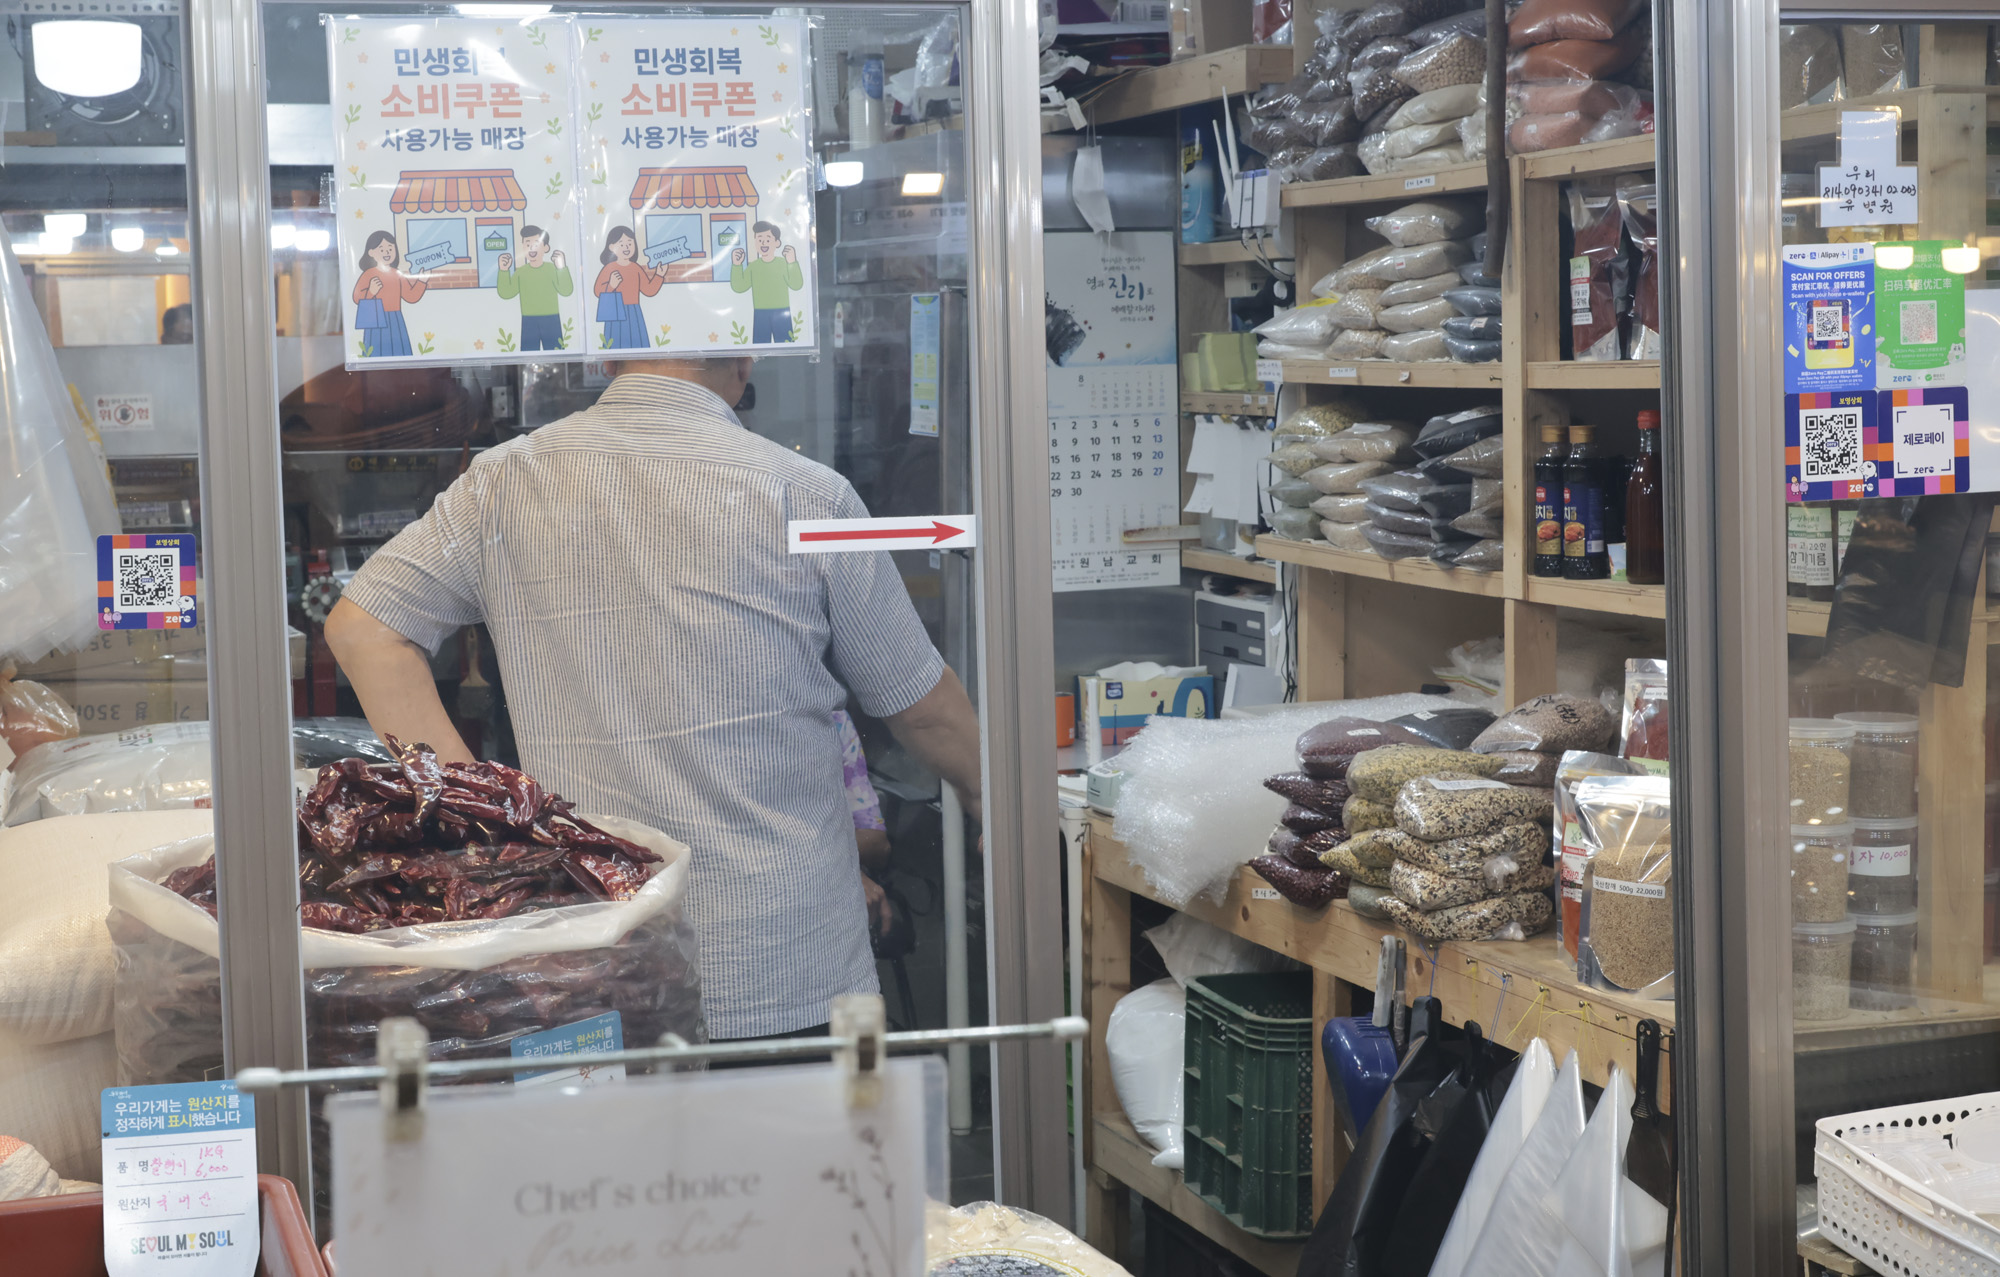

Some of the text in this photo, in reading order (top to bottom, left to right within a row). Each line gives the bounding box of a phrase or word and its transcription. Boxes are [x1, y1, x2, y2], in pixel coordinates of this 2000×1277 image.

[393, 47, 506, 76] 민생회
[634, 46, 743, 76] 민생회복
[380, 82, 523, 120] 소비쿠폰
[621, 81, 757, 118] 소비쿠폰
[381, 126, 527, 152] 사용가능 매장
[621, 125, 760, 150] 사용가능 매장
[1846, 165, 1875, 181] 우리
[485, 240, 506, 249] OPEN
[414, 250, 443, 267] COUPON
[652, 246, 680, 262] COUPON
[1086, 276, 1105, 290] 영과
[1790, 271, 1865, 281] SCAN FOR OFFERS
[1051, 418, 1161, 431] 1 2 3 4 5 6
[1051, 434, 1163, 447] 8 9 10 11 12 13
[1903, 431, 1945, 445] 제로페이
[1050, 450, 1164, 464] 15 16 17 18 19 20
[1051, 467, 1163, 480] 22 23 24 25 26 27
[1913, 465, 1934, 475] zero
[1051, 487, 1082, 498] 29 30
[1849, 482, 1874, 493] zero
[155, 539, 180, 547] 보영상회
[165, 613, 192, 624] zero
[1879, 849, 1908, 861] 10,000
[1595, 880, 1663, 896] 국산참깨 500g 22,000원
[523, 1025, 613, 1060] 우리가게는 원산지를
[114, 1094, 241, 1116] 우리가게는 원산지를
[115, 1110, 241, 1133] 정직하게 표시했습니다
[195, 1163, 229, 1178] 6,000
[515, 1169, 762, 1217] Chef's choice
[118, 1197, 151, 1211] 원산지
[130, 1235, 173, 1255] SEOUL
[199, 1229, 234, 1249] SOUL
